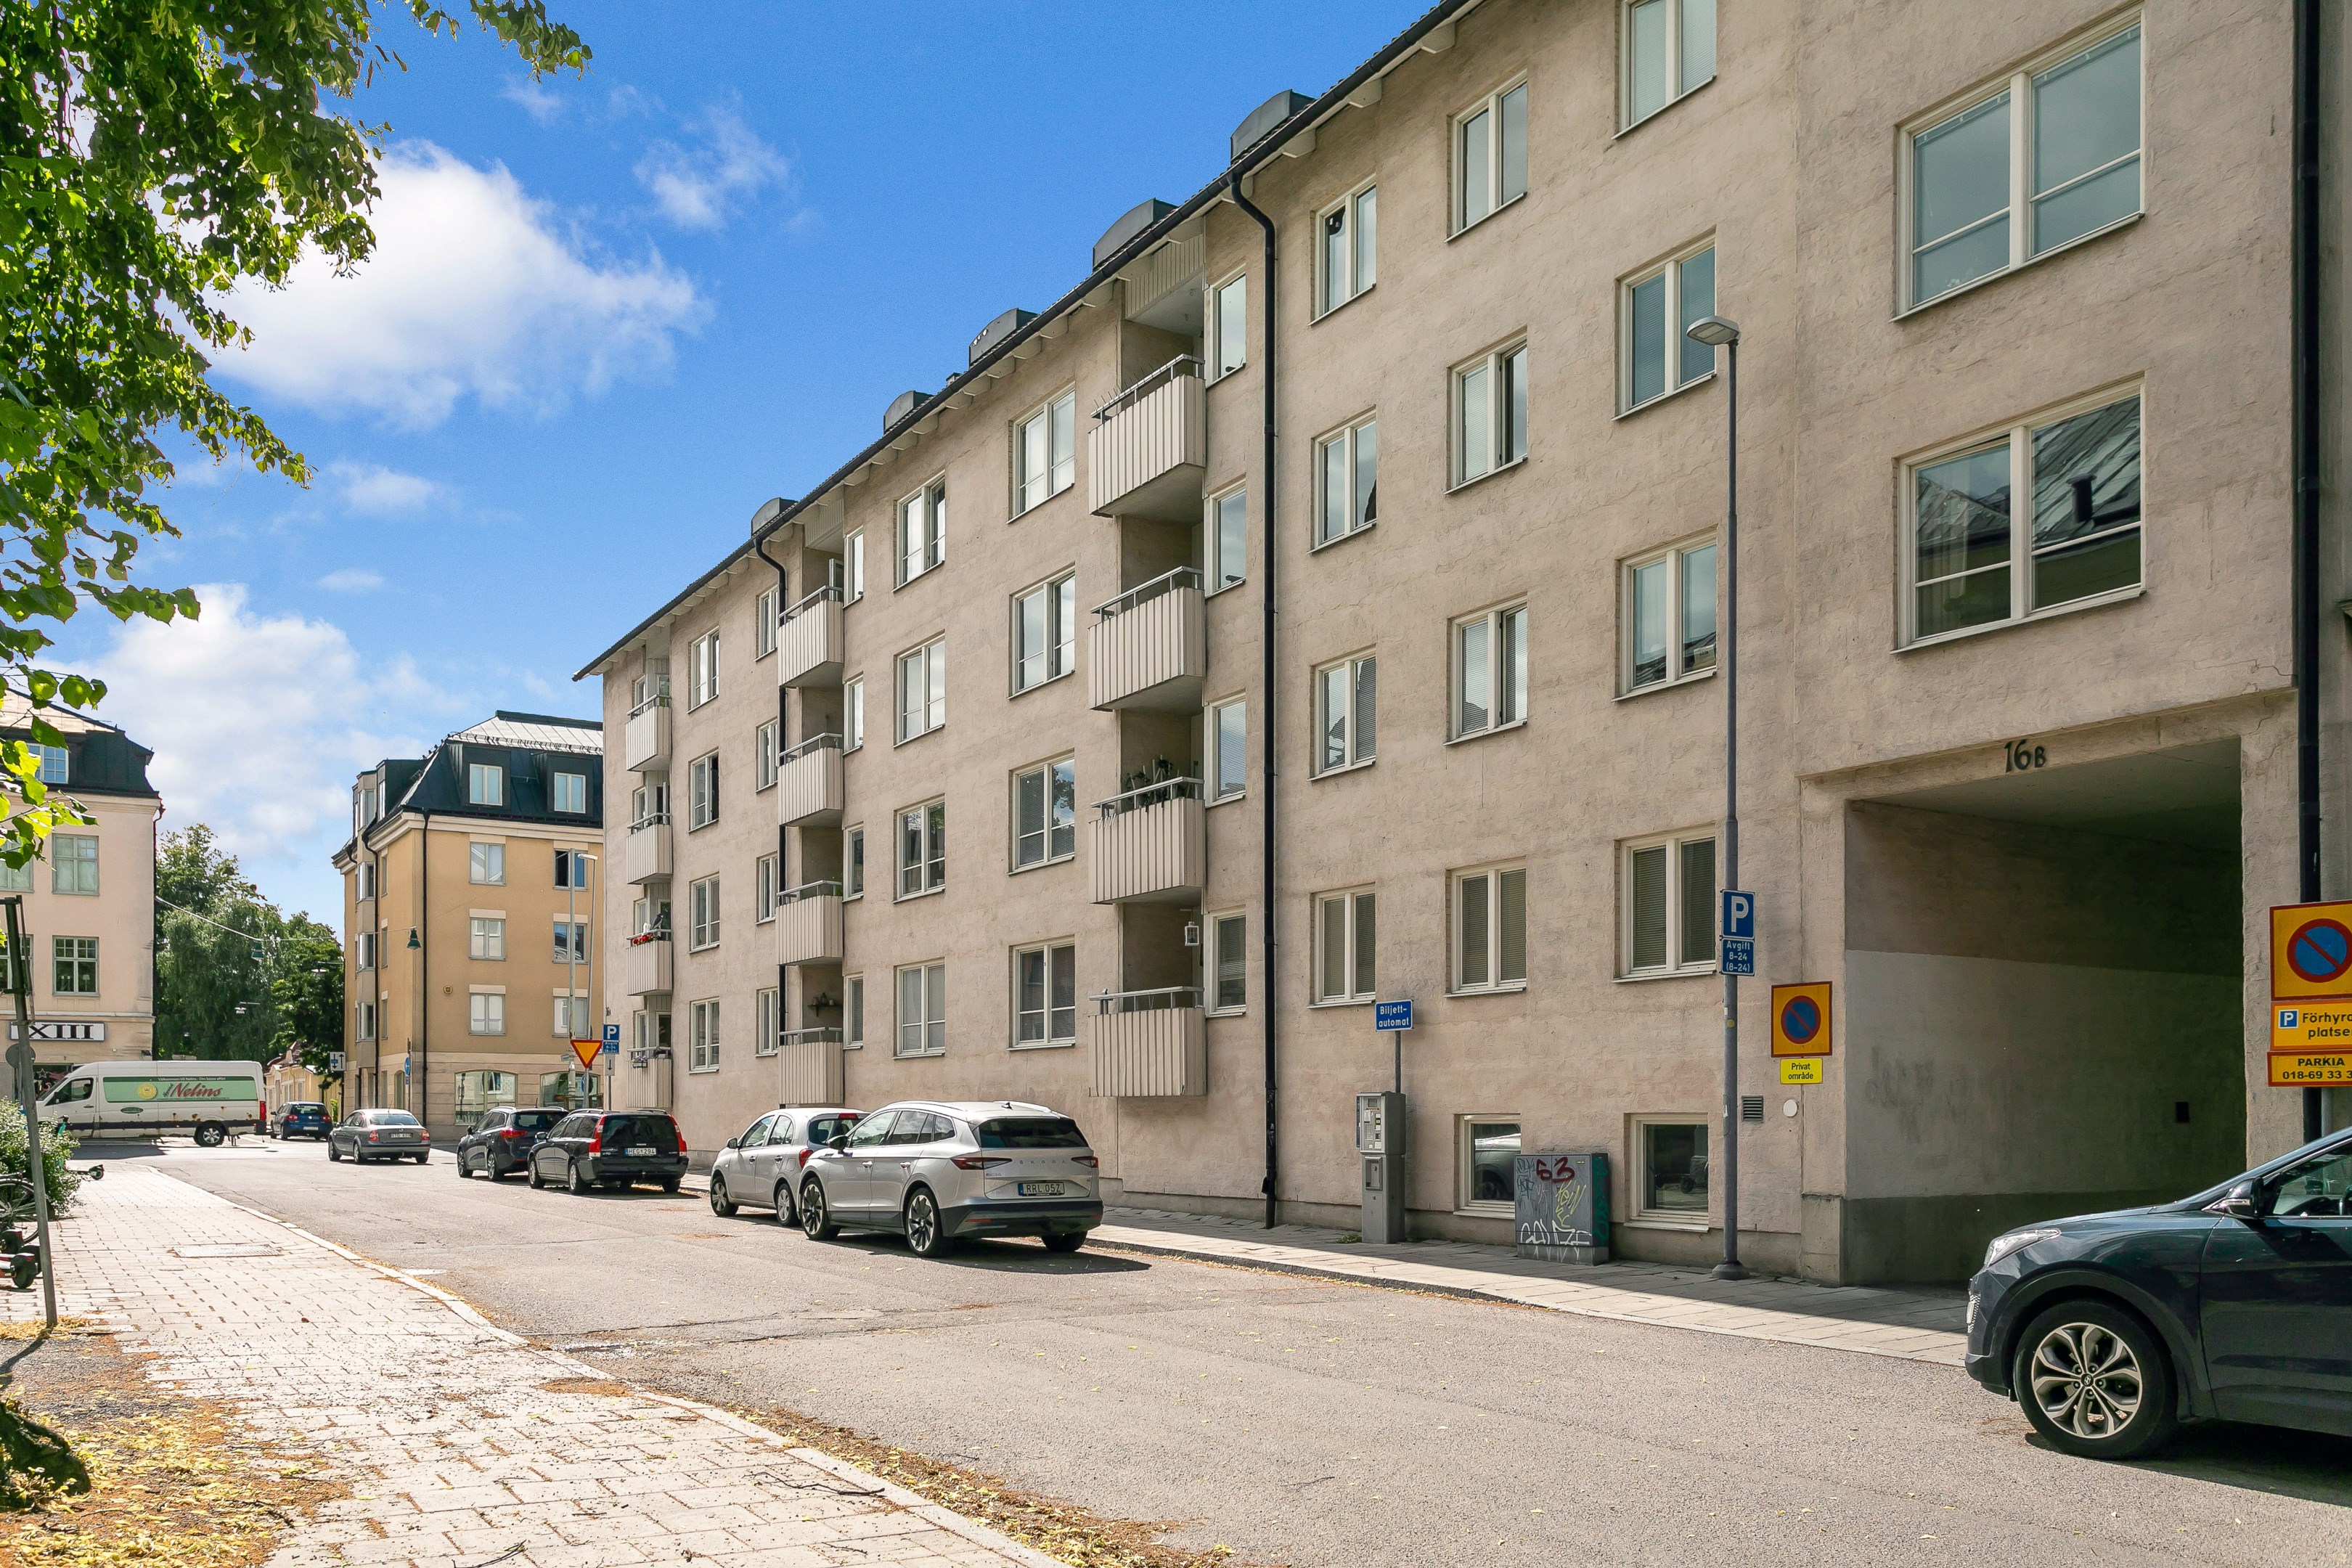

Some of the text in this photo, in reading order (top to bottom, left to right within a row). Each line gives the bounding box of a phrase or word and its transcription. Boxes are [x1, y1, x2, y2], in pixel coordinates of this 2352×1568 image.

[1731, 896, 1749, 932] P
[1727, 941, 1750, 951] Avgift
[1729, 952, 1747, 960] 8-24
[1726, 962, 1750, 973] (8-24)
[1380, 1005, 1407, 1016] Biljett-
[1379, 1017, 1409, 1027] automat
[607, 1026, 617, 1040] P
[2308, 1026, 2352, 1040] platse
[2298, 1057, 2345, 1066] PARKIA
[2282, 1071, 2323, 1079] 018-69
[2327, 1070, 2342, 1079] 33
[170, 1082, 223, 1098] Nelins
[1026, 1184, 1042, 1193] RRL
